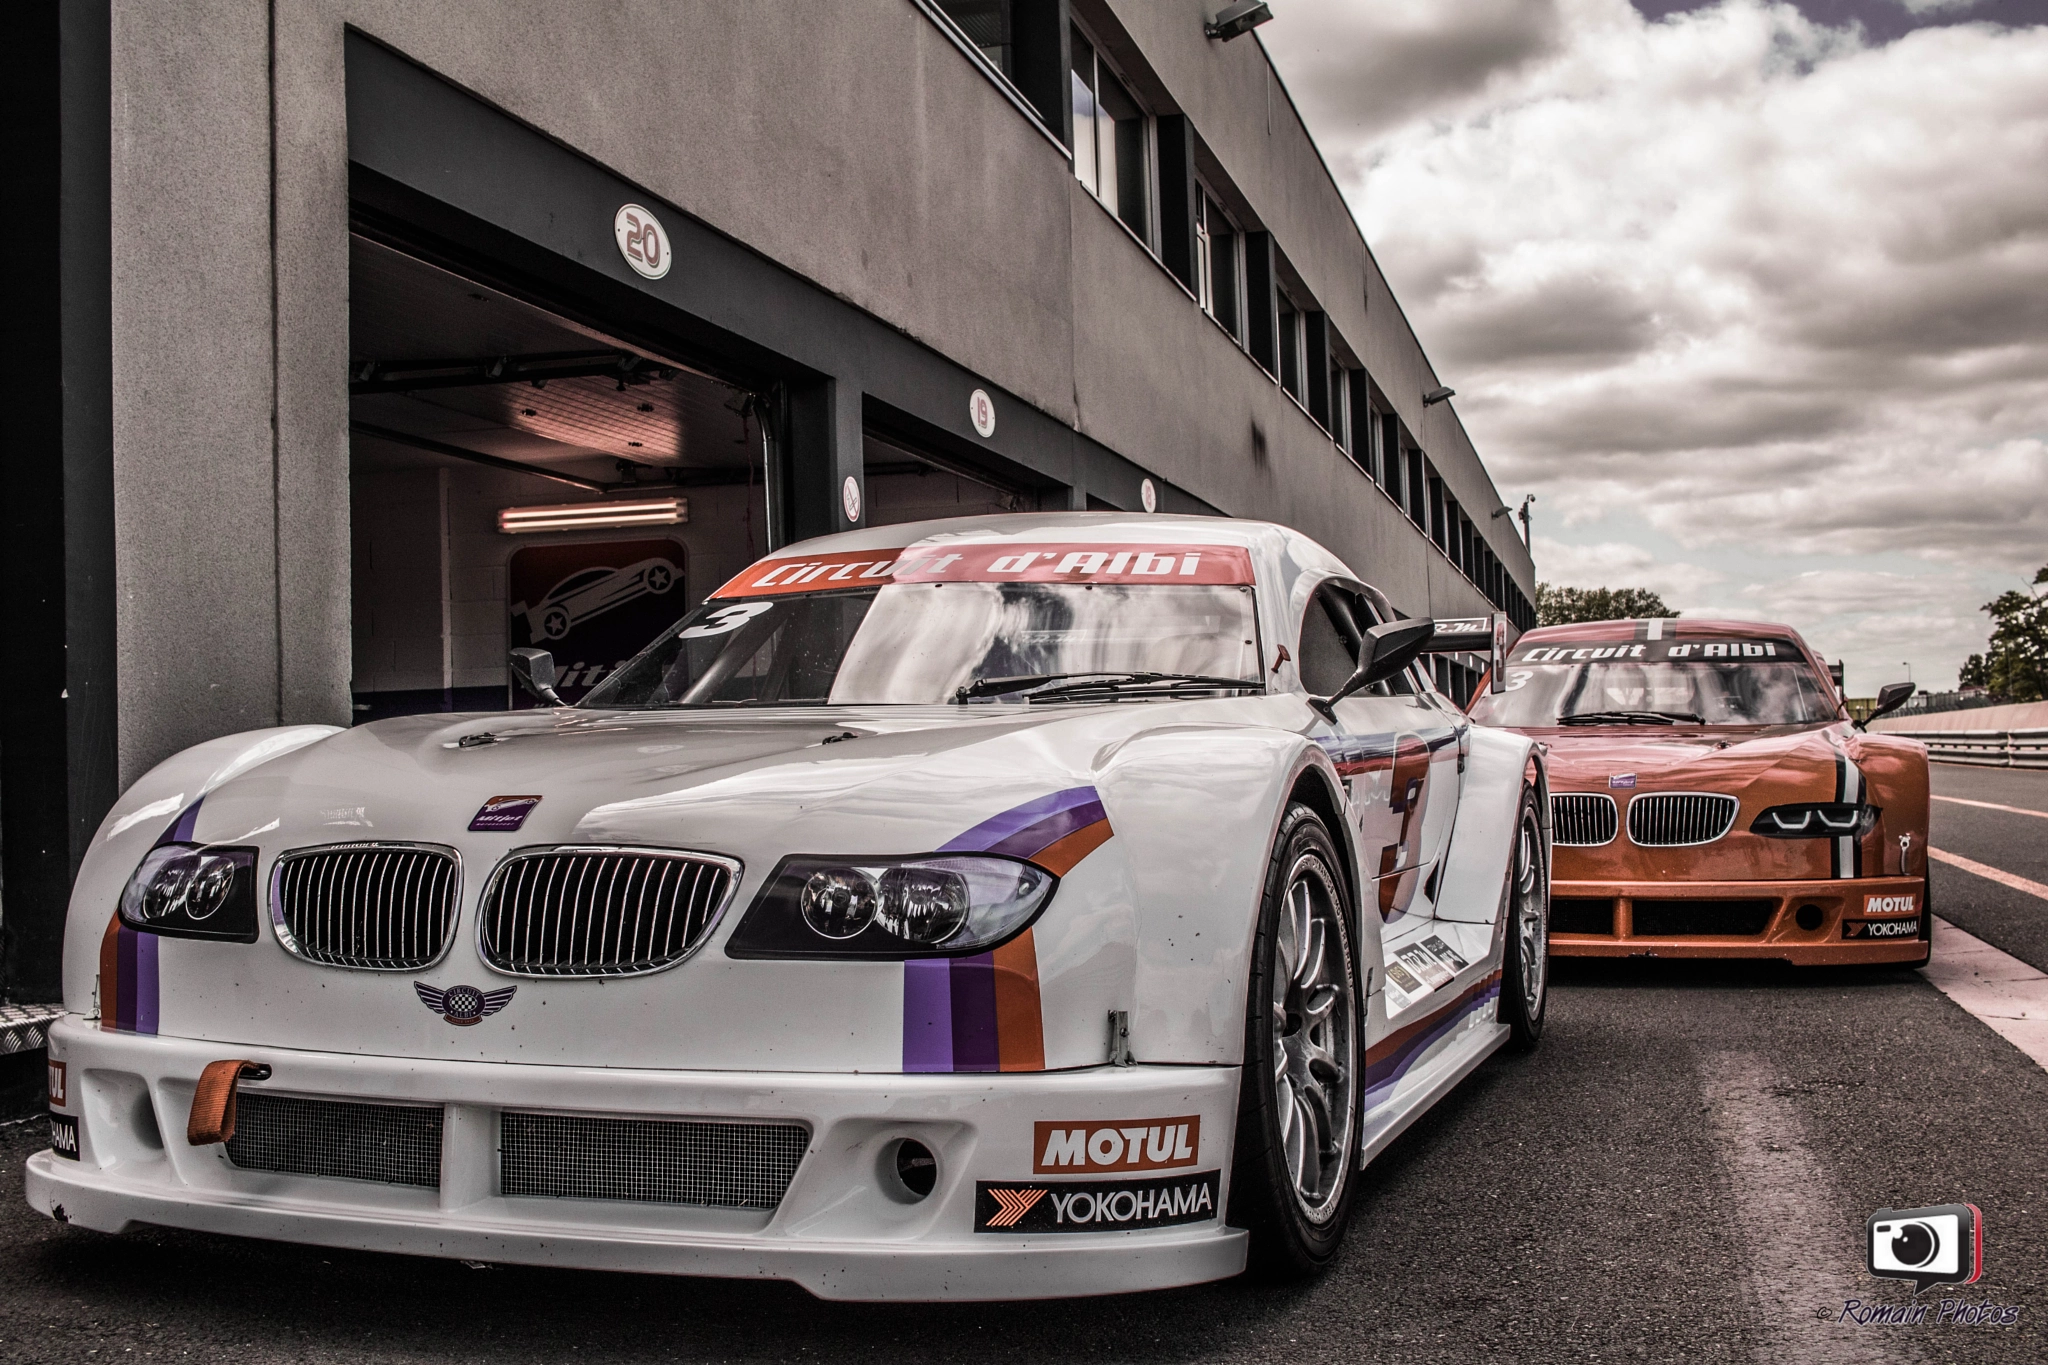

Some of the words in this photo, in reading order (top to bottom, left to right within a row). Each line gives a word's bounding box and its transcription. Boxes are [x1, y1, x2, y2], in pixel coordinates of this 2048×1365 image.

[626, 212, 660, 268] 20
[977, 396, 988, 429] 19
[751, 553, 963, 588] Circuit
[987, 549, 1201, 576] d'Albi
[678, 602, 774, 639] 3
[1522, 644, 1647, 662] Circuit
[1668, 643, 1776, 657] d'Albi
[1505, 671, 1534, 691] 3
[1866, 896, 1915, 913] MOTUL
[1867, 920, 1918, 936] YOKOHAMA
[448, 988, 479, 998] CIRCUIT
[1041, 1124, 1193, 1166] MOTUL
[1050, 1182, 1212, 1224] YOKOHAMA
